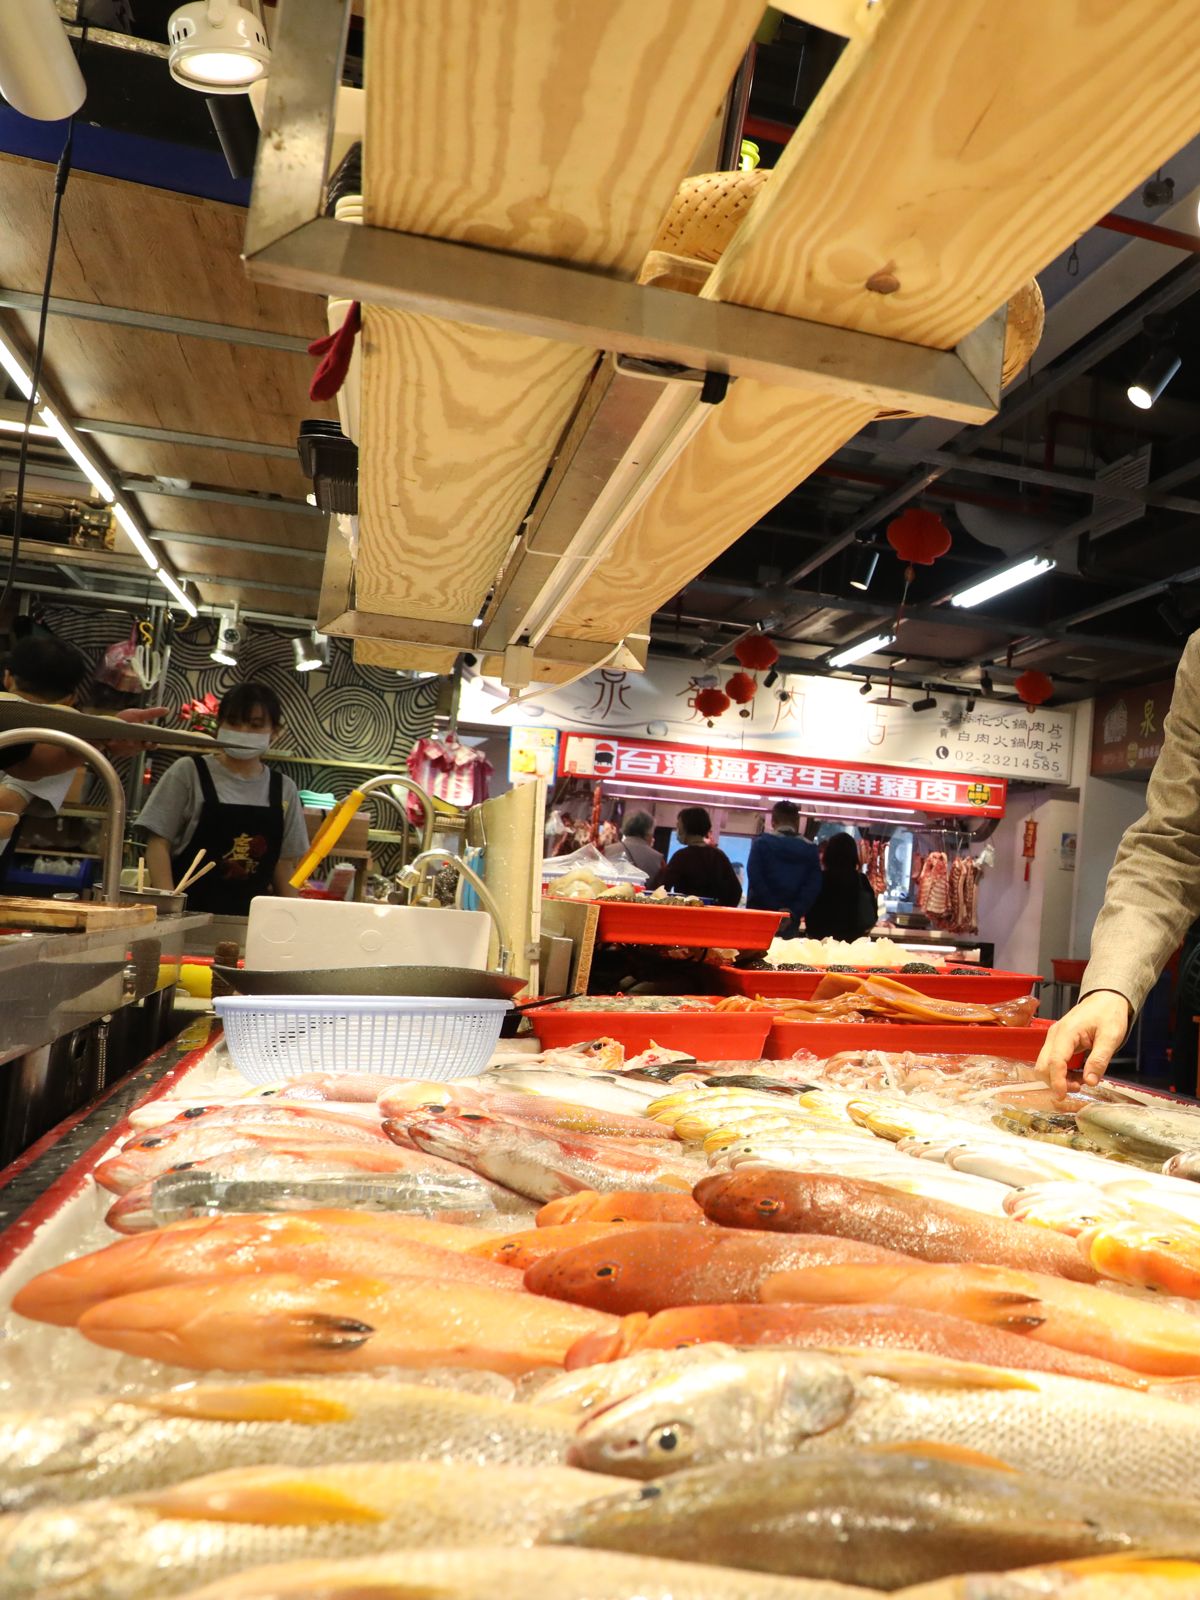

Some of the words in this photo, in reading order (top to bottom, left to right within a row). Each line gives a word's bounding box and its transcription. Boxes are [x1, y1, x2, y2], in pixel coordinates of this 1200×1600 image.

[590, 667, 890, 747] 泉肉店
[954, 750, 1061, 773] 02-23214585
[957, 730, 1063, 754] 白肉火鍋肉片
[617, 750, 958, 804] 台灣溫控生鮮豬肉
